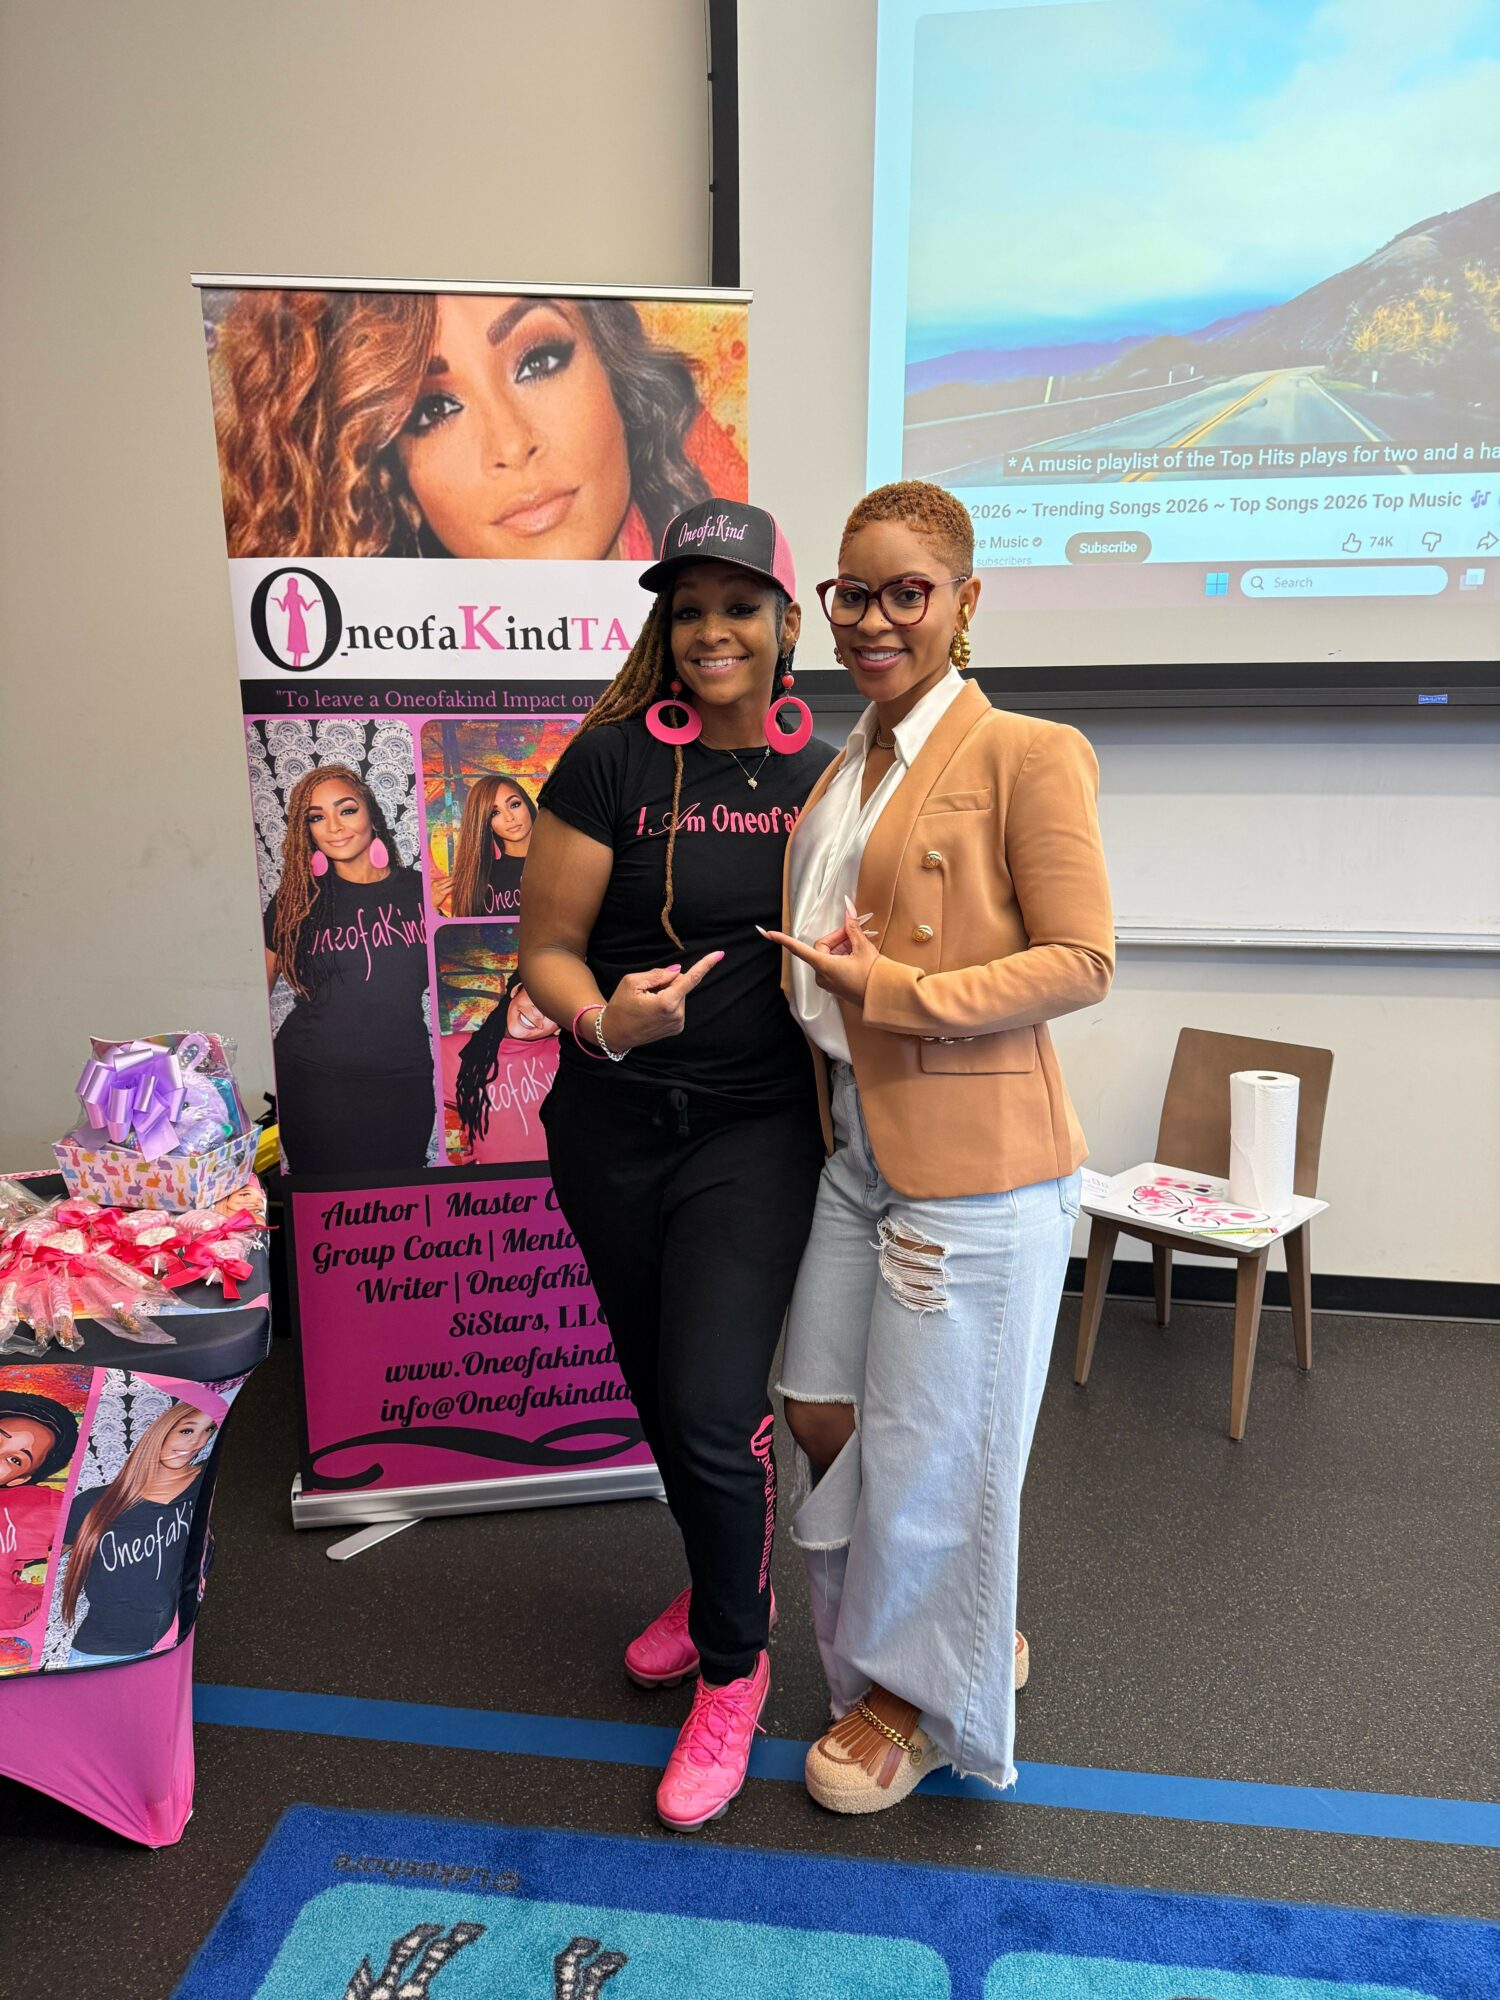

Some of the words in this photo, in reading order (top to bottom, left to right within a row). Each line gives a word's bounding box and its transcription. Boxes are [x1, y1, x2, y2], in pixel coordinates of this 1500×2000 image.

[1020, 456, 1034, 473] A
[1039, 454, 1092, 472] music
[1096, 451, 1159, 475] playlist
[1163, 450, 1183, 468] of
[1187, 449, 1215, 467] the
[1219, 450, 1253, 469] Top
[1257, 447, 1295, 466] Hits
[1299, 446, 1348, 468] plays
[1352, 445, 1380, 463] for
[1384, 446, 1418, 461] two
[1423, 442, 1458, 461] and
[1463, 448, 1474, 460] a
[971, 504, 1012, 520] 2026
[1032, 500, 1105, 519] Trending
[1109, 500, 1161, 518] Songs
[1166, 498, 1209, 514] 2026
[1229, 497, 1261, 515] Top
[1265, 495, 1319, 514] Songs
[1324, 494, 1368, 510] 2026
[1372, 493, 1404, 512] Top
[1409, 491, 1462, 508] Music
[678, 514, 749, 548] OneofaKind
[990, 535, 1029, 549] Music
[1369, 536, 1394, 548] 74K
[976, 556, 1032, 567] subscribers
[1079, 541, 1138, 555] Subscribe
[1273, 577, 1313, 589] Search
[276, 690, 309, 708] "To
[314, 690, 364, 708] leave
[369, 694, 380, 708] a
[384, 689, 497, 708] Oneofakind
[502, 690, 567, 712] Impact
[636, 806, 647, 836] I
[648, 802, 706, 836] Am
[446, 1191, 538, 1219] Master
[312, 1241, 395, 1275] Group
[449, 1309, 550, 1339] SiStars,
